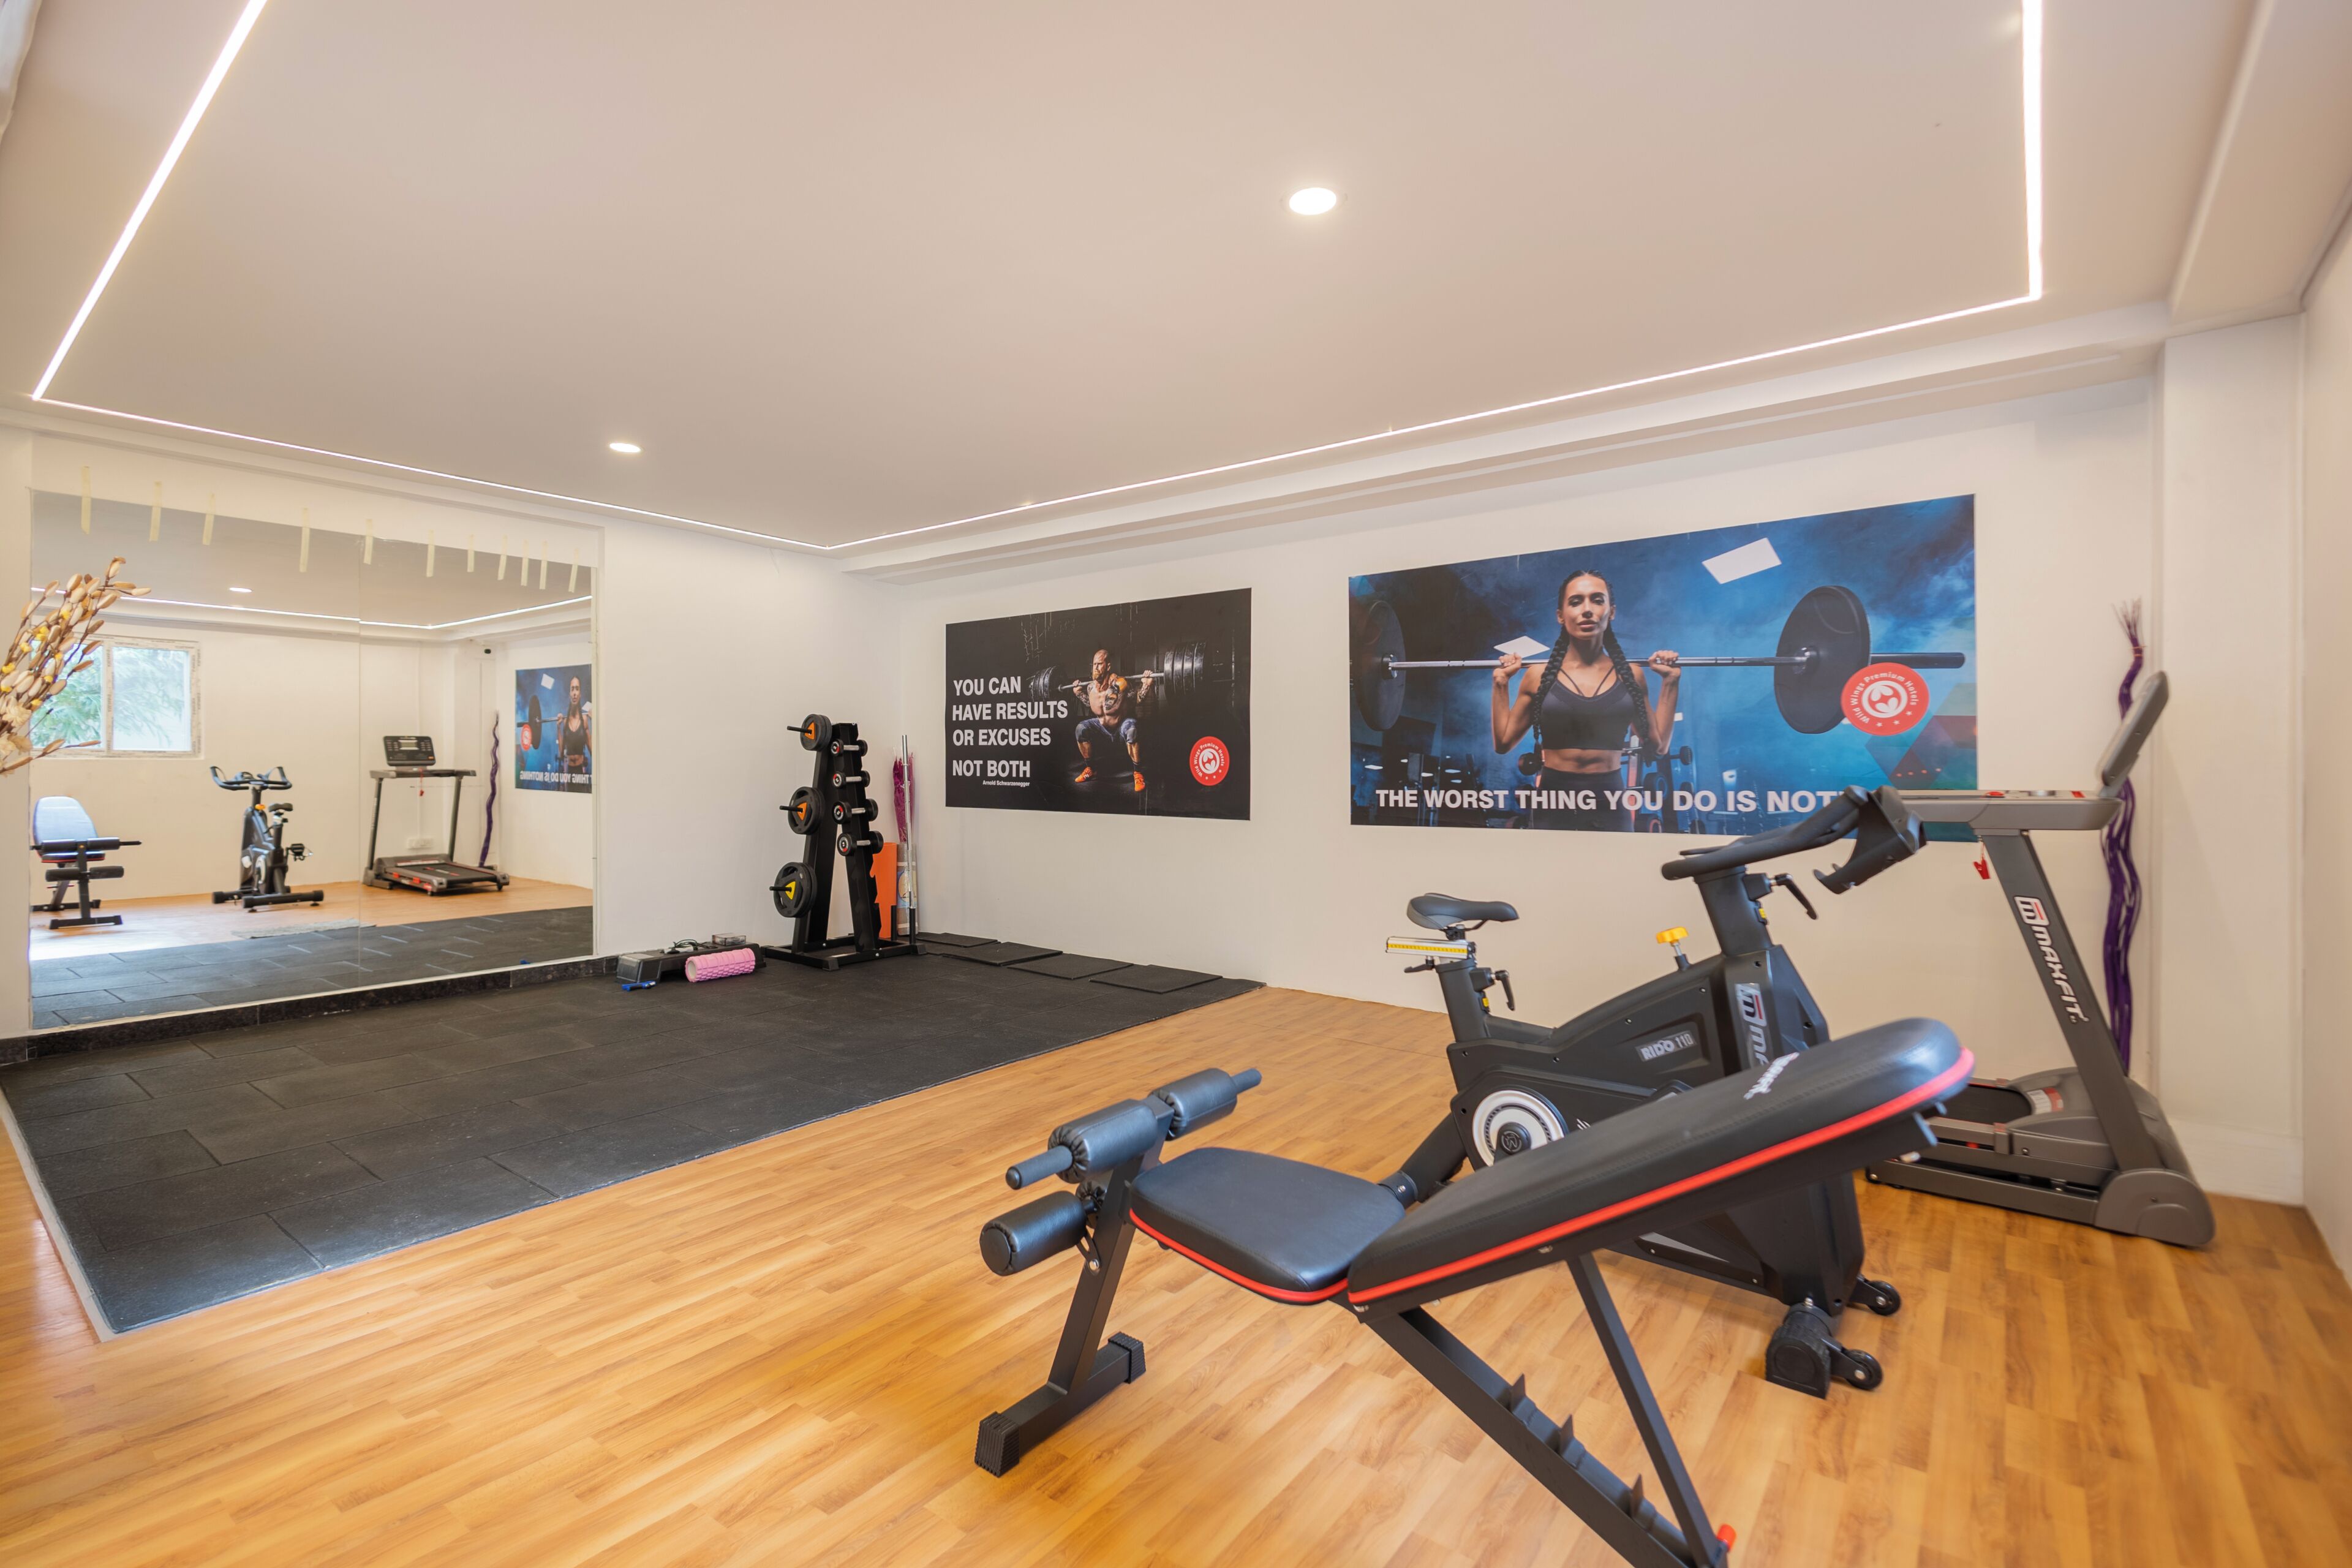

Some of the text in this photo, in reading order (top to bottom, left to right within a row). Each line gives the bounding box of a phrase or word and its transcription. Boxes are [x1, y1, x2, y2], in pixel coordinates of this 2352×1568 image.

[953, 676, 1021, 696] YOU CAN
[1850, 672, 1919, 723] Wild Wings Premium Hotels
[952, 700, 1068, 721] HAVE RESULTS
[952, 727, 1051, 746] OR EXCUSES
[952, 760, 1030, 778] NOT BOTH
[1376, 790, 1844, 813] THE WORST THING YOU DO IS NOT
[1675, 1033, 1694, 1049] 110
